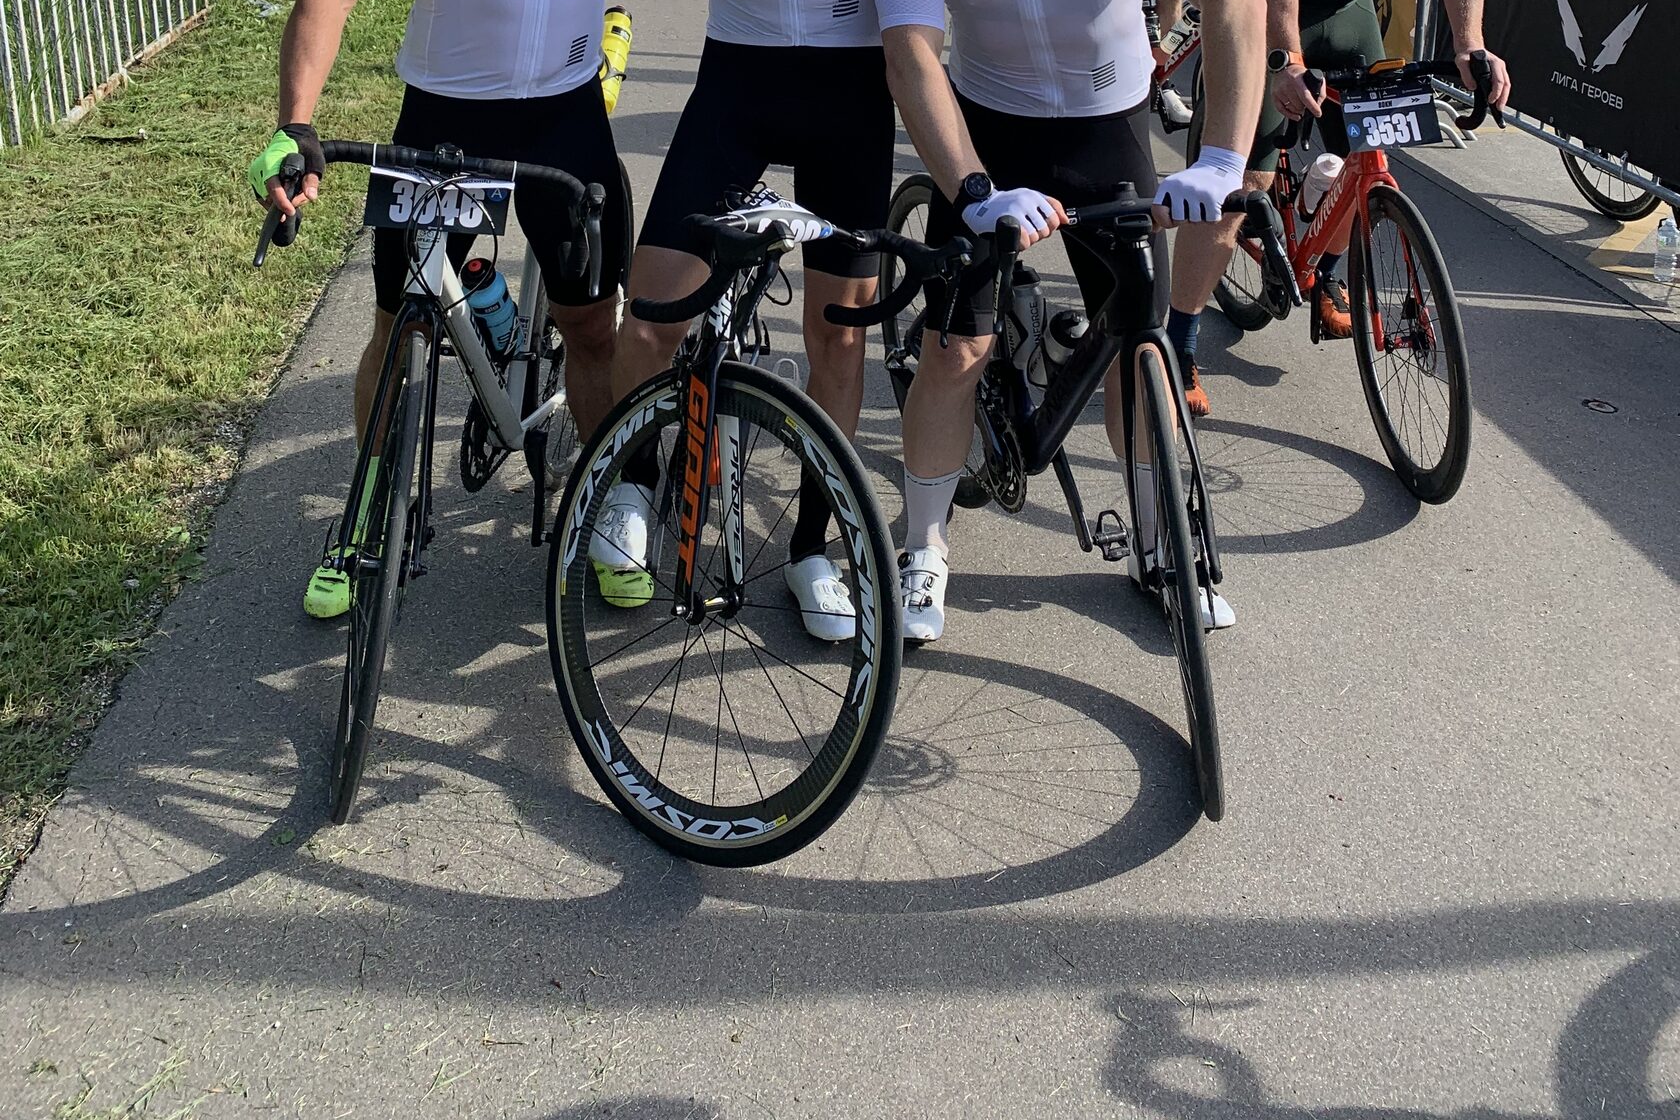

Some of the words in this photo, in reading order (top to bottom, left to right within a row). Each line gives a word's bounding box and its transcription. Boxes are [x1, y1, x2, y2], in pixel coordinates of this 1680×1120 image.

[1550, 71, 1578, 92] ЛИГА
[1581, 82, 1624, 110] ГЕРОЕВ
[1362, 111, 1422, 147] 3531
[388, 180, 486, 229] 3046
[491, 188, 503, 199] A
[678, 374, 709, 586] GIANT
[729, 435, 742, 577] PROPEL
